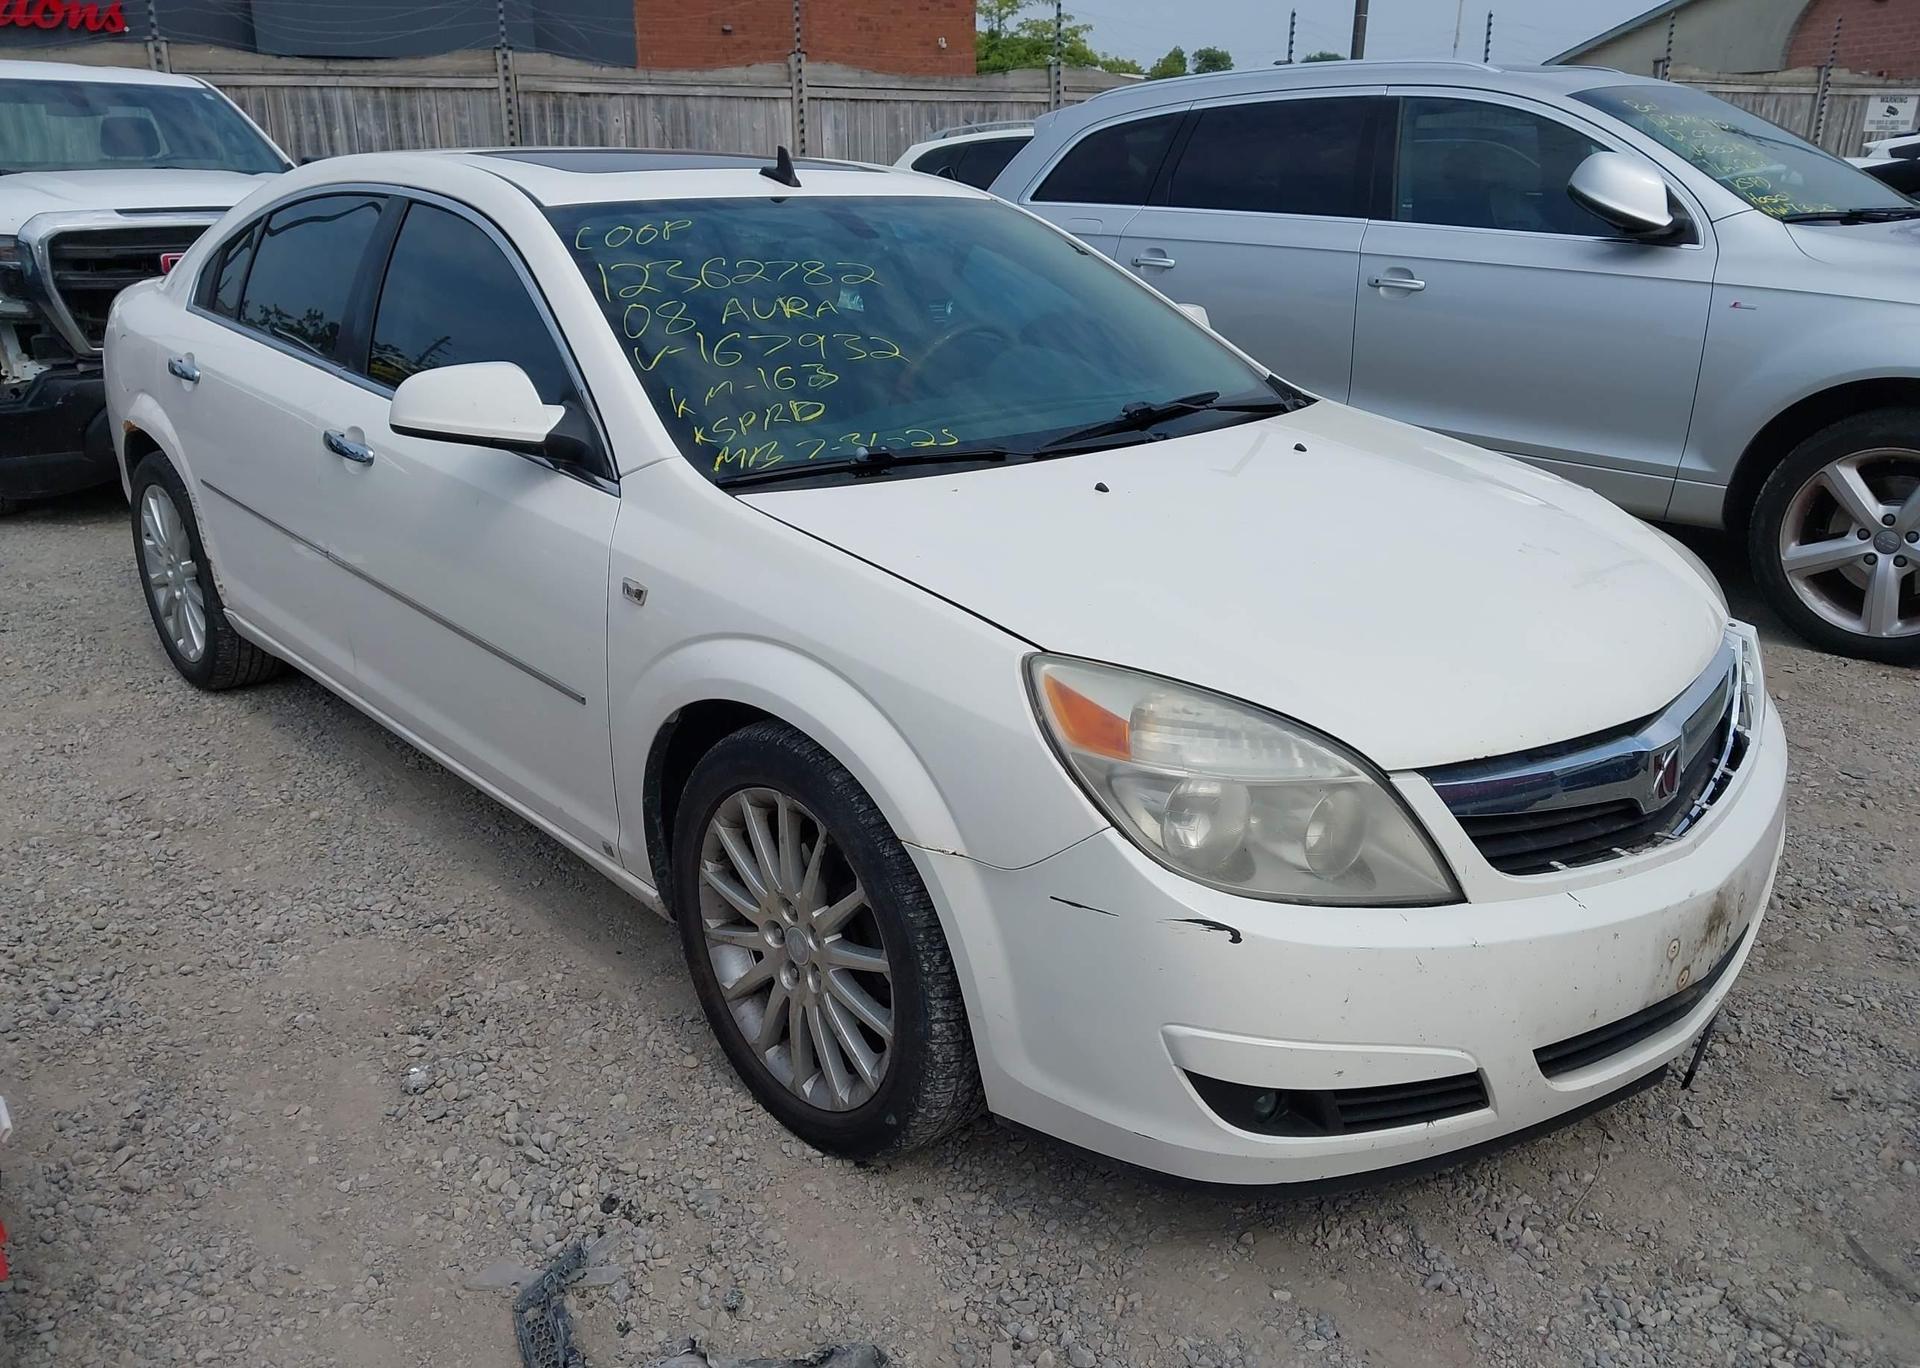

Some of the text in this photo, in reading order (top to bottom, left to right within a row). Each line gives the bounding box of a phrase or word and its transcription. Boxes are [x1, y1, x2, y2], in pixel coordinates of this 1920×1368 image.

[575, 219, 693, 250] COOP
[598, 257, 886, 302] 12362782
[623, 297, 839, 338] 08 AURA
